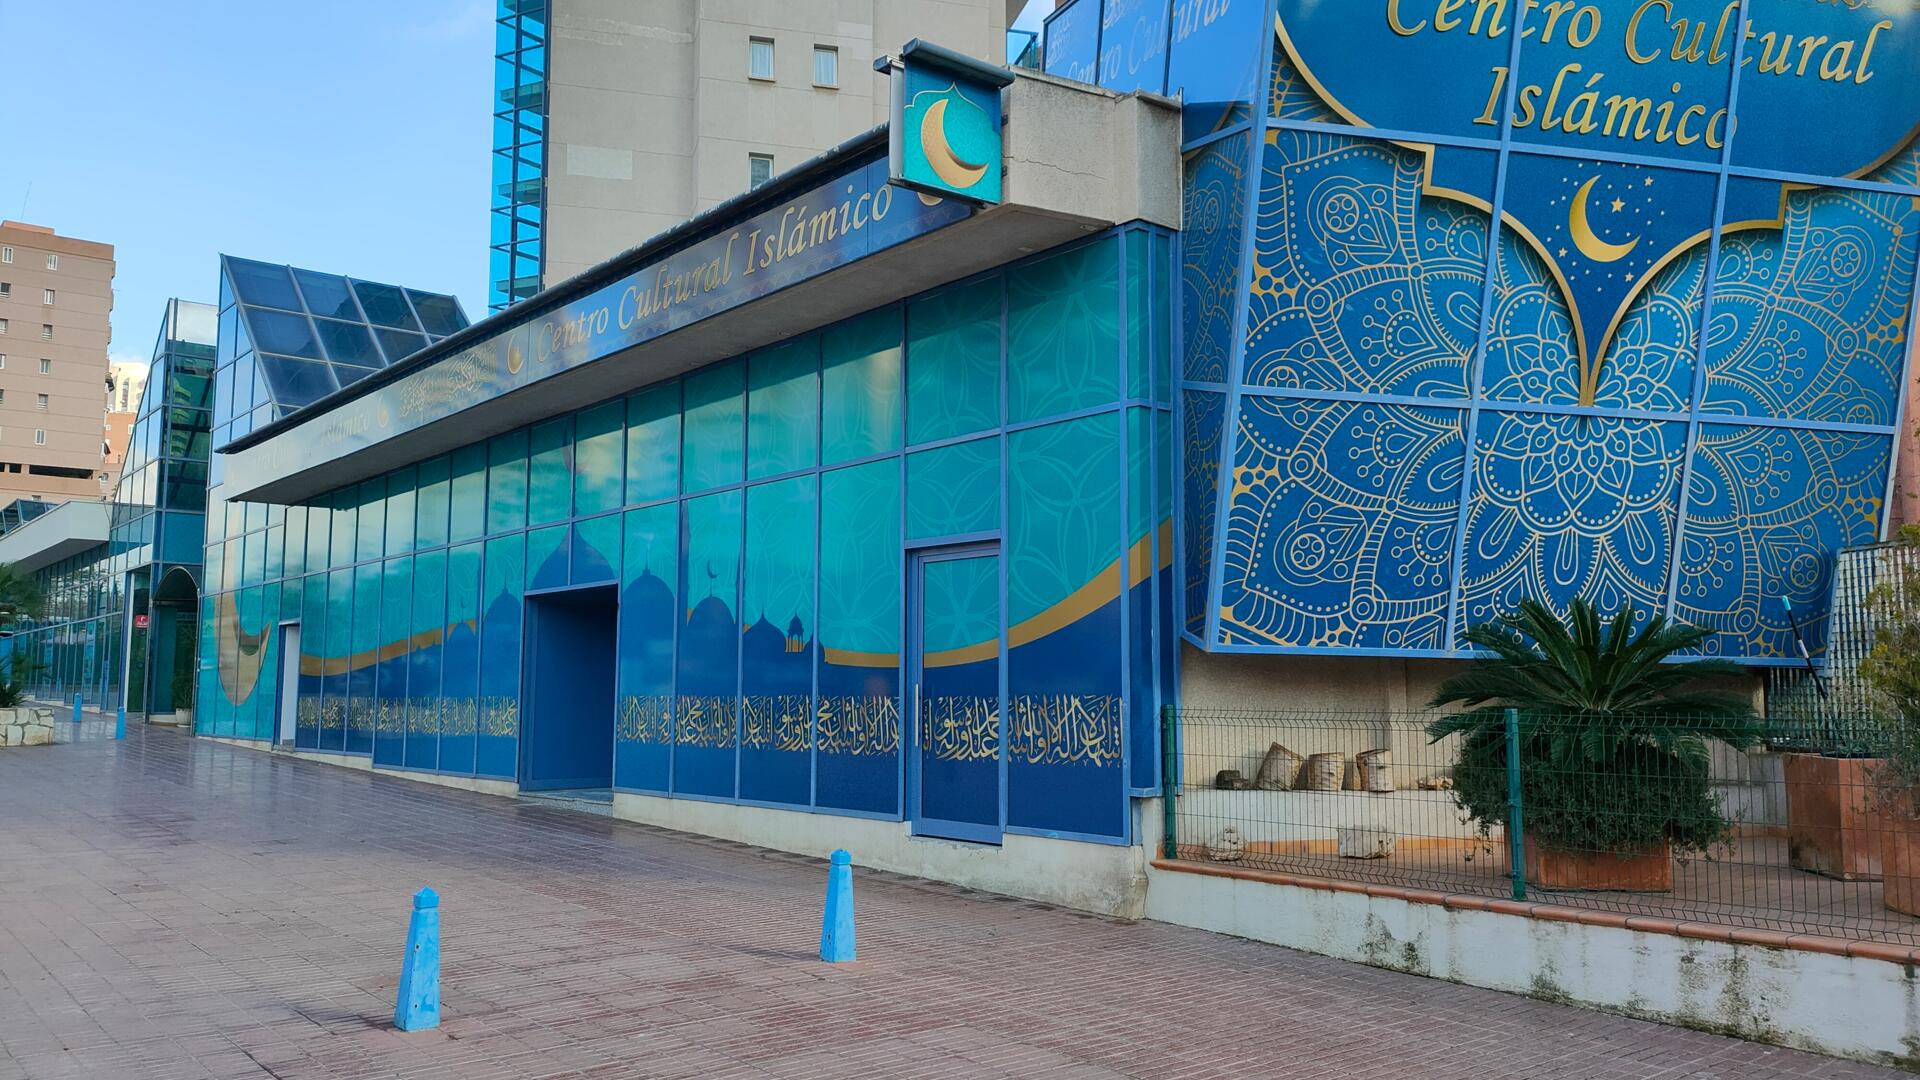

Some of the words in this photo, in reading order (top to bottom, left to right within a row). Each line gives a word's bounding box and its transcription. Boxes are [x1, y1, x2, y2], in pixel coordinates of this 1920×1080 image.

[1473, 63, 1738, 149] Islámico
[536, 305, 609, 362] Centro
[618, 231, 739, 331] Cultural
[743, 183, 893, 276] Islámico
